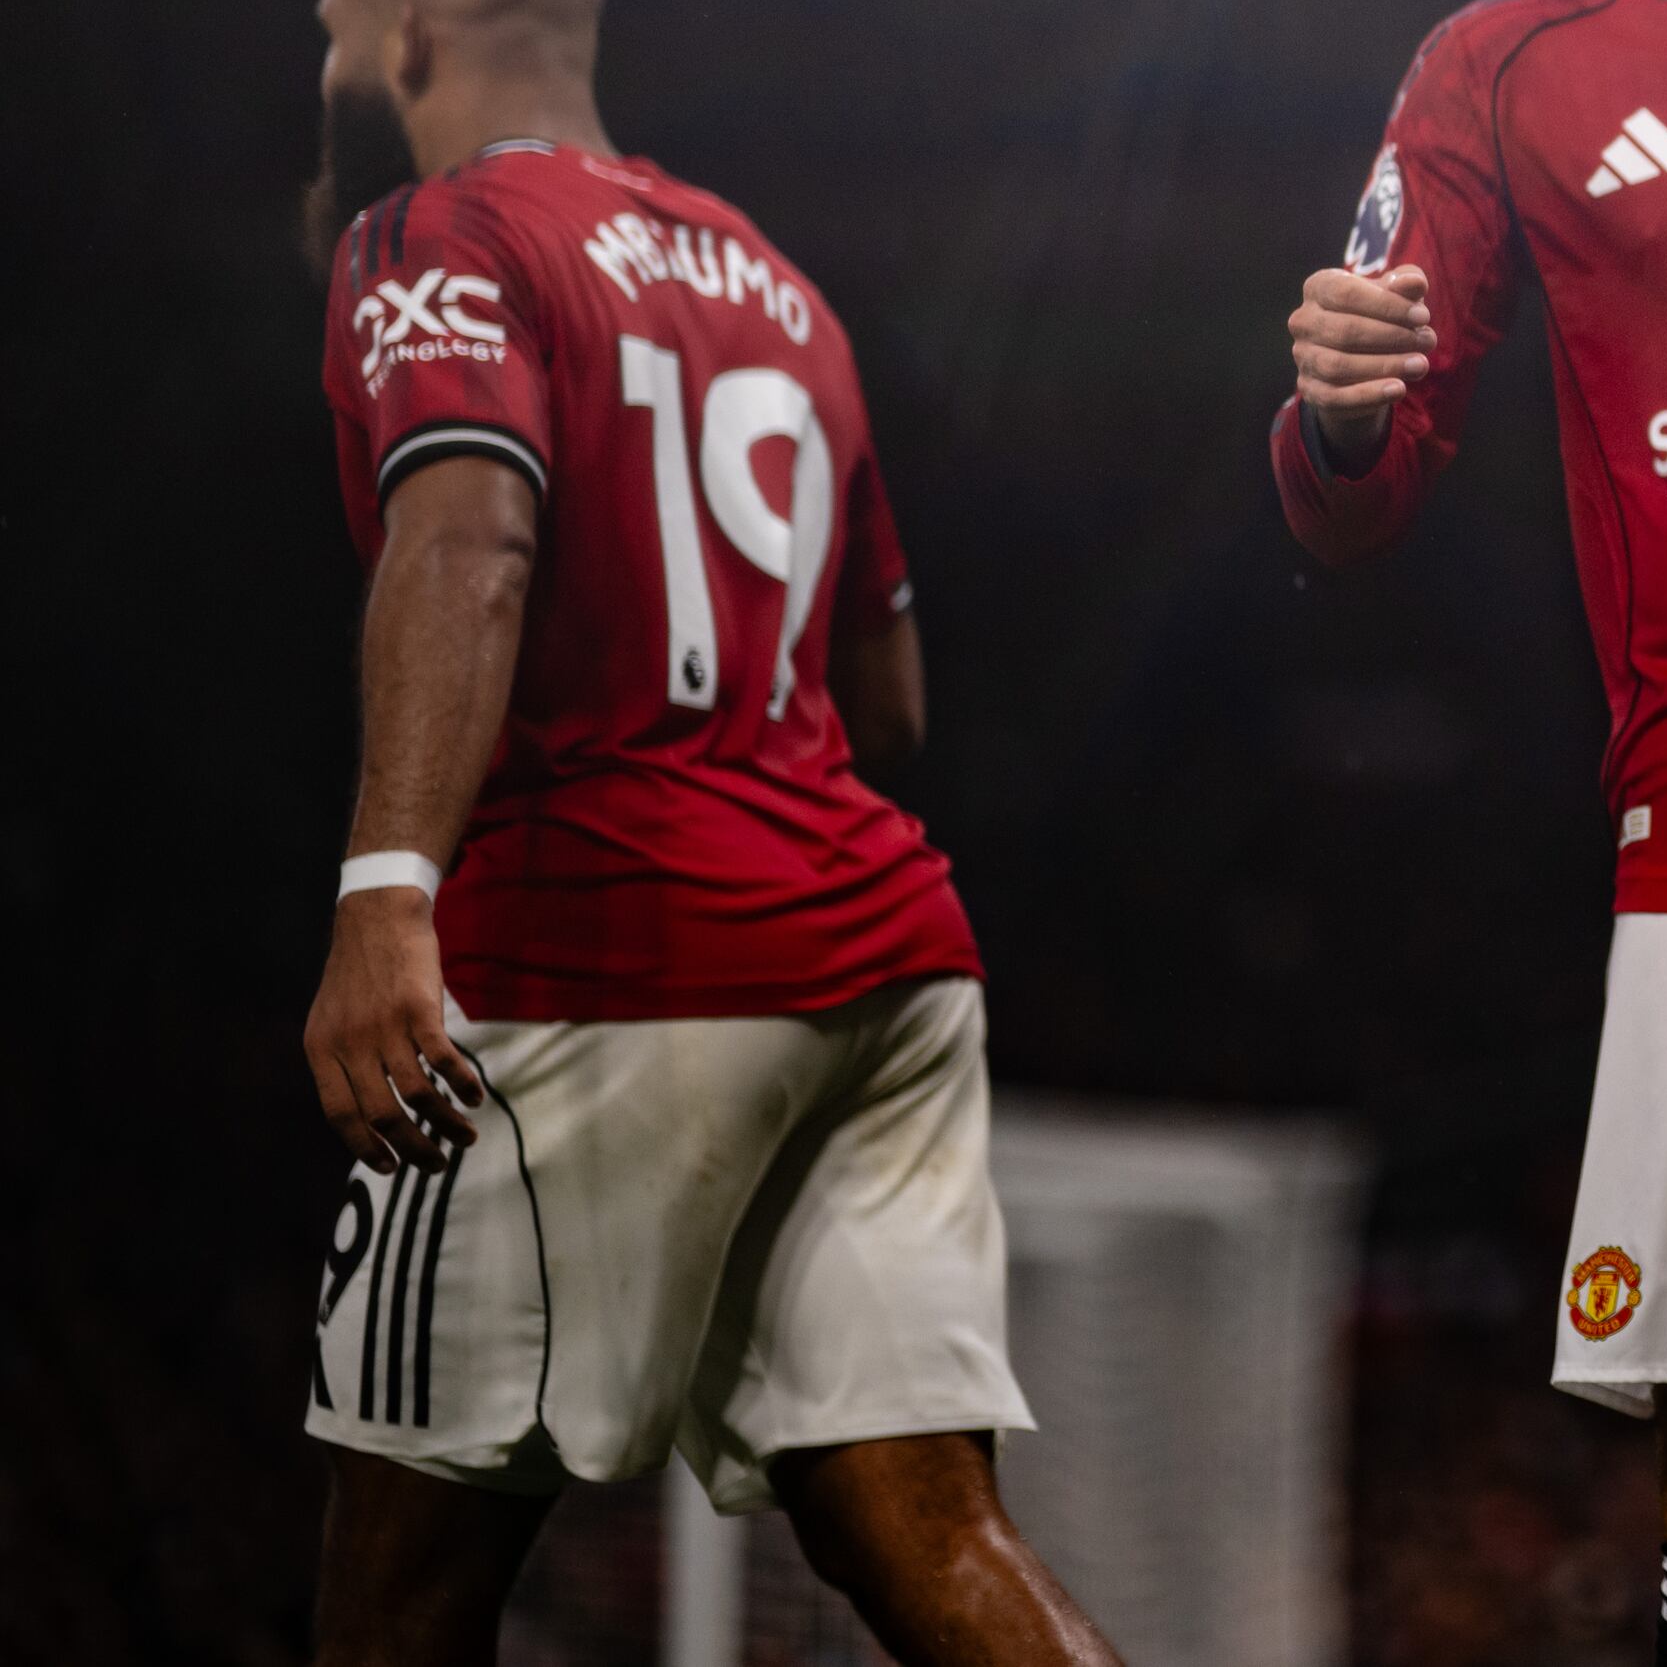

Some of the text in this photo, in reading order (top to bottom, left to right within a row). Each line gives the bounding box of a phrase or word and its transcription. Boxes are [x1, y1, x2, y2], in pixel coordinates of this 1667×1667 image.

[583, 212, 811, 346] MBUMO
[620, 334, 834, 722] 19
[1577, 1318, 1621, 1335] UNITED
